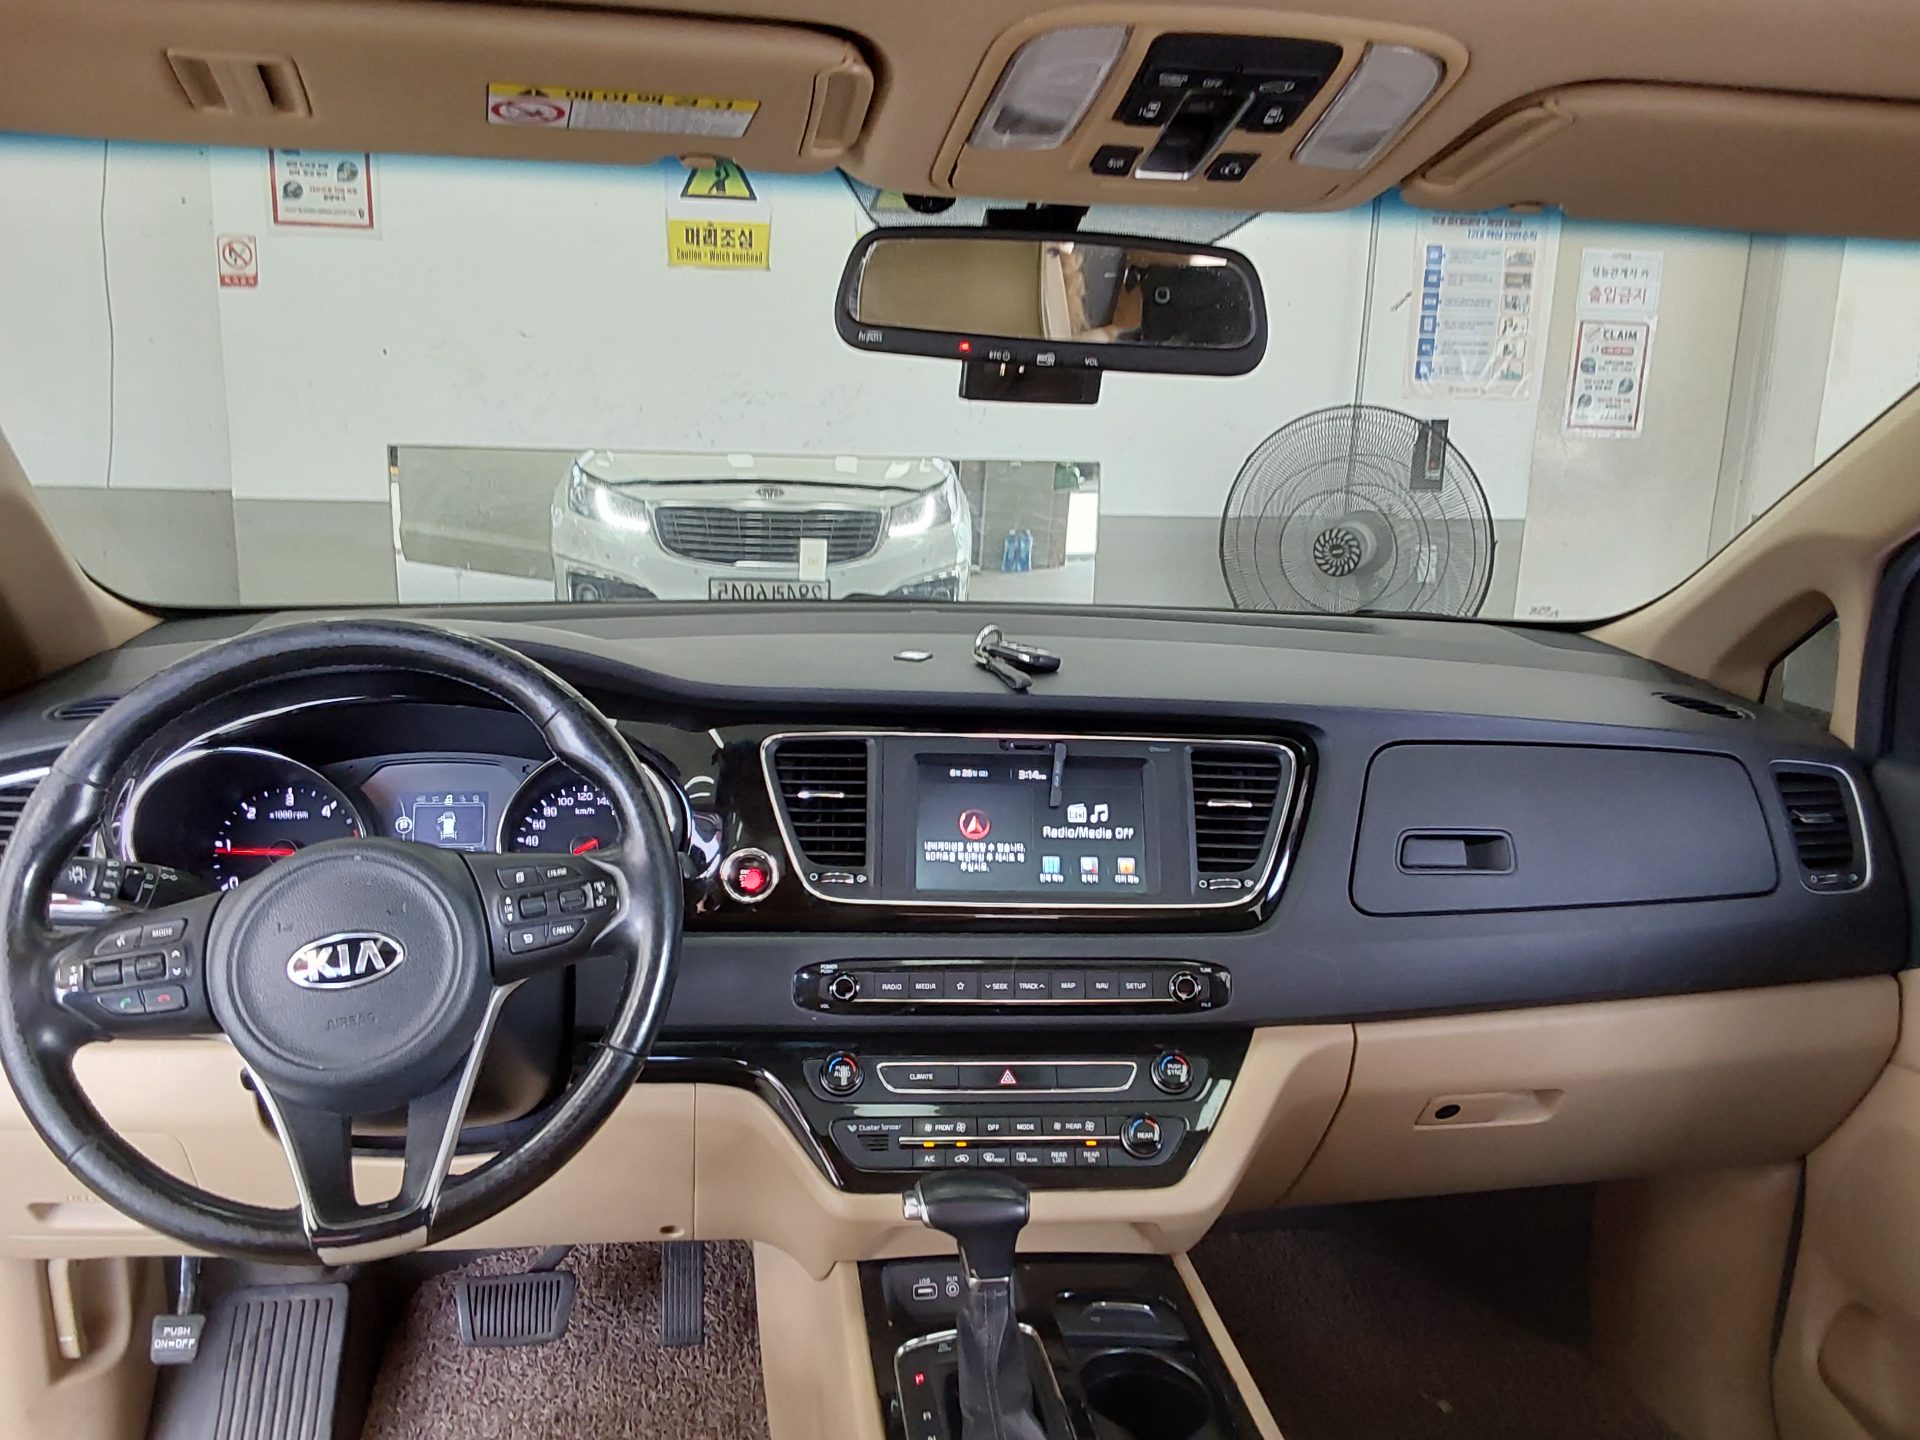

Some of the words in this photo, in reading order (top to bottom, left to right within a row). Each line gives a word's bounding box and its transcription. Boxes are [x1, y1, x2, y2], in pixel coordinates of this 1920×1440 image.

[684, 225, 753, 249] 머리조심
[676, 246, 702, 260] Caution
[709, 249, 730, 263] Watch
[1588, 285, 1647, 305] 출입금지
[1603, 329, 1638, 341] CLAIM
[1084, 357, 1099, 367] VOL
[285, 793, 294, 806] 3
[558, 797, 573, 806] 100
[577, 792, 593, 801] 120
[247, 806, 256, 819] 2
[321, 805, 331, 818] 4
[543, 806, 557, 817] 80
[575, 807, 594, 815] km/h
[532, 819, 546, 830] 60
[1042, 826, 1113, 840] Radio/Media
[525, 836, 538, 846] 40
[229, 876, 239, 890] 0
[152, 927, 173, 938] MODE
[552, 925, 574, 936] CANCEL
[303, 940, 386, 982] KIA
[858, 1123, 880, 1131] Cluster
[1016, 1123, 1035, 1131] MODE
[163, 1326, 191, 1337] PUSH
[154, 1338, 168, 1349] ON
[176, 1338, 195, 1349] OFF
